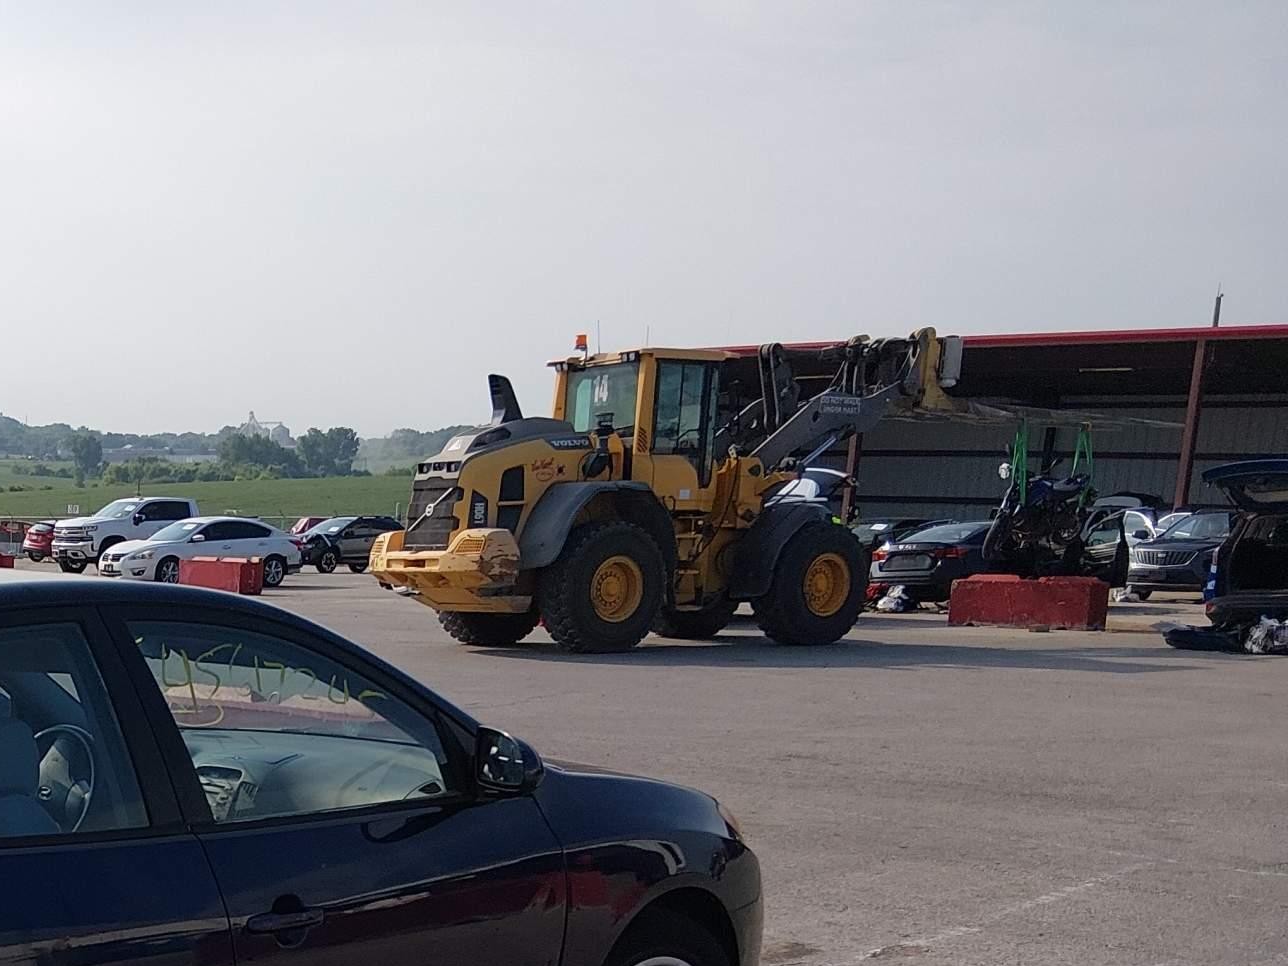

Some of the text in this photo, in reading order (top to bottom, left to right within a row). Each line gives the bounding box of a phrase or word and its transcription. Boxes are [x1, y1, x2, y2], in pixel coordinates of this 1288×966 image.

[593, 374, 609, 404] 14
[551, 439, 589, 448] VOLVO
[473, 502, 486, 524] L90H
